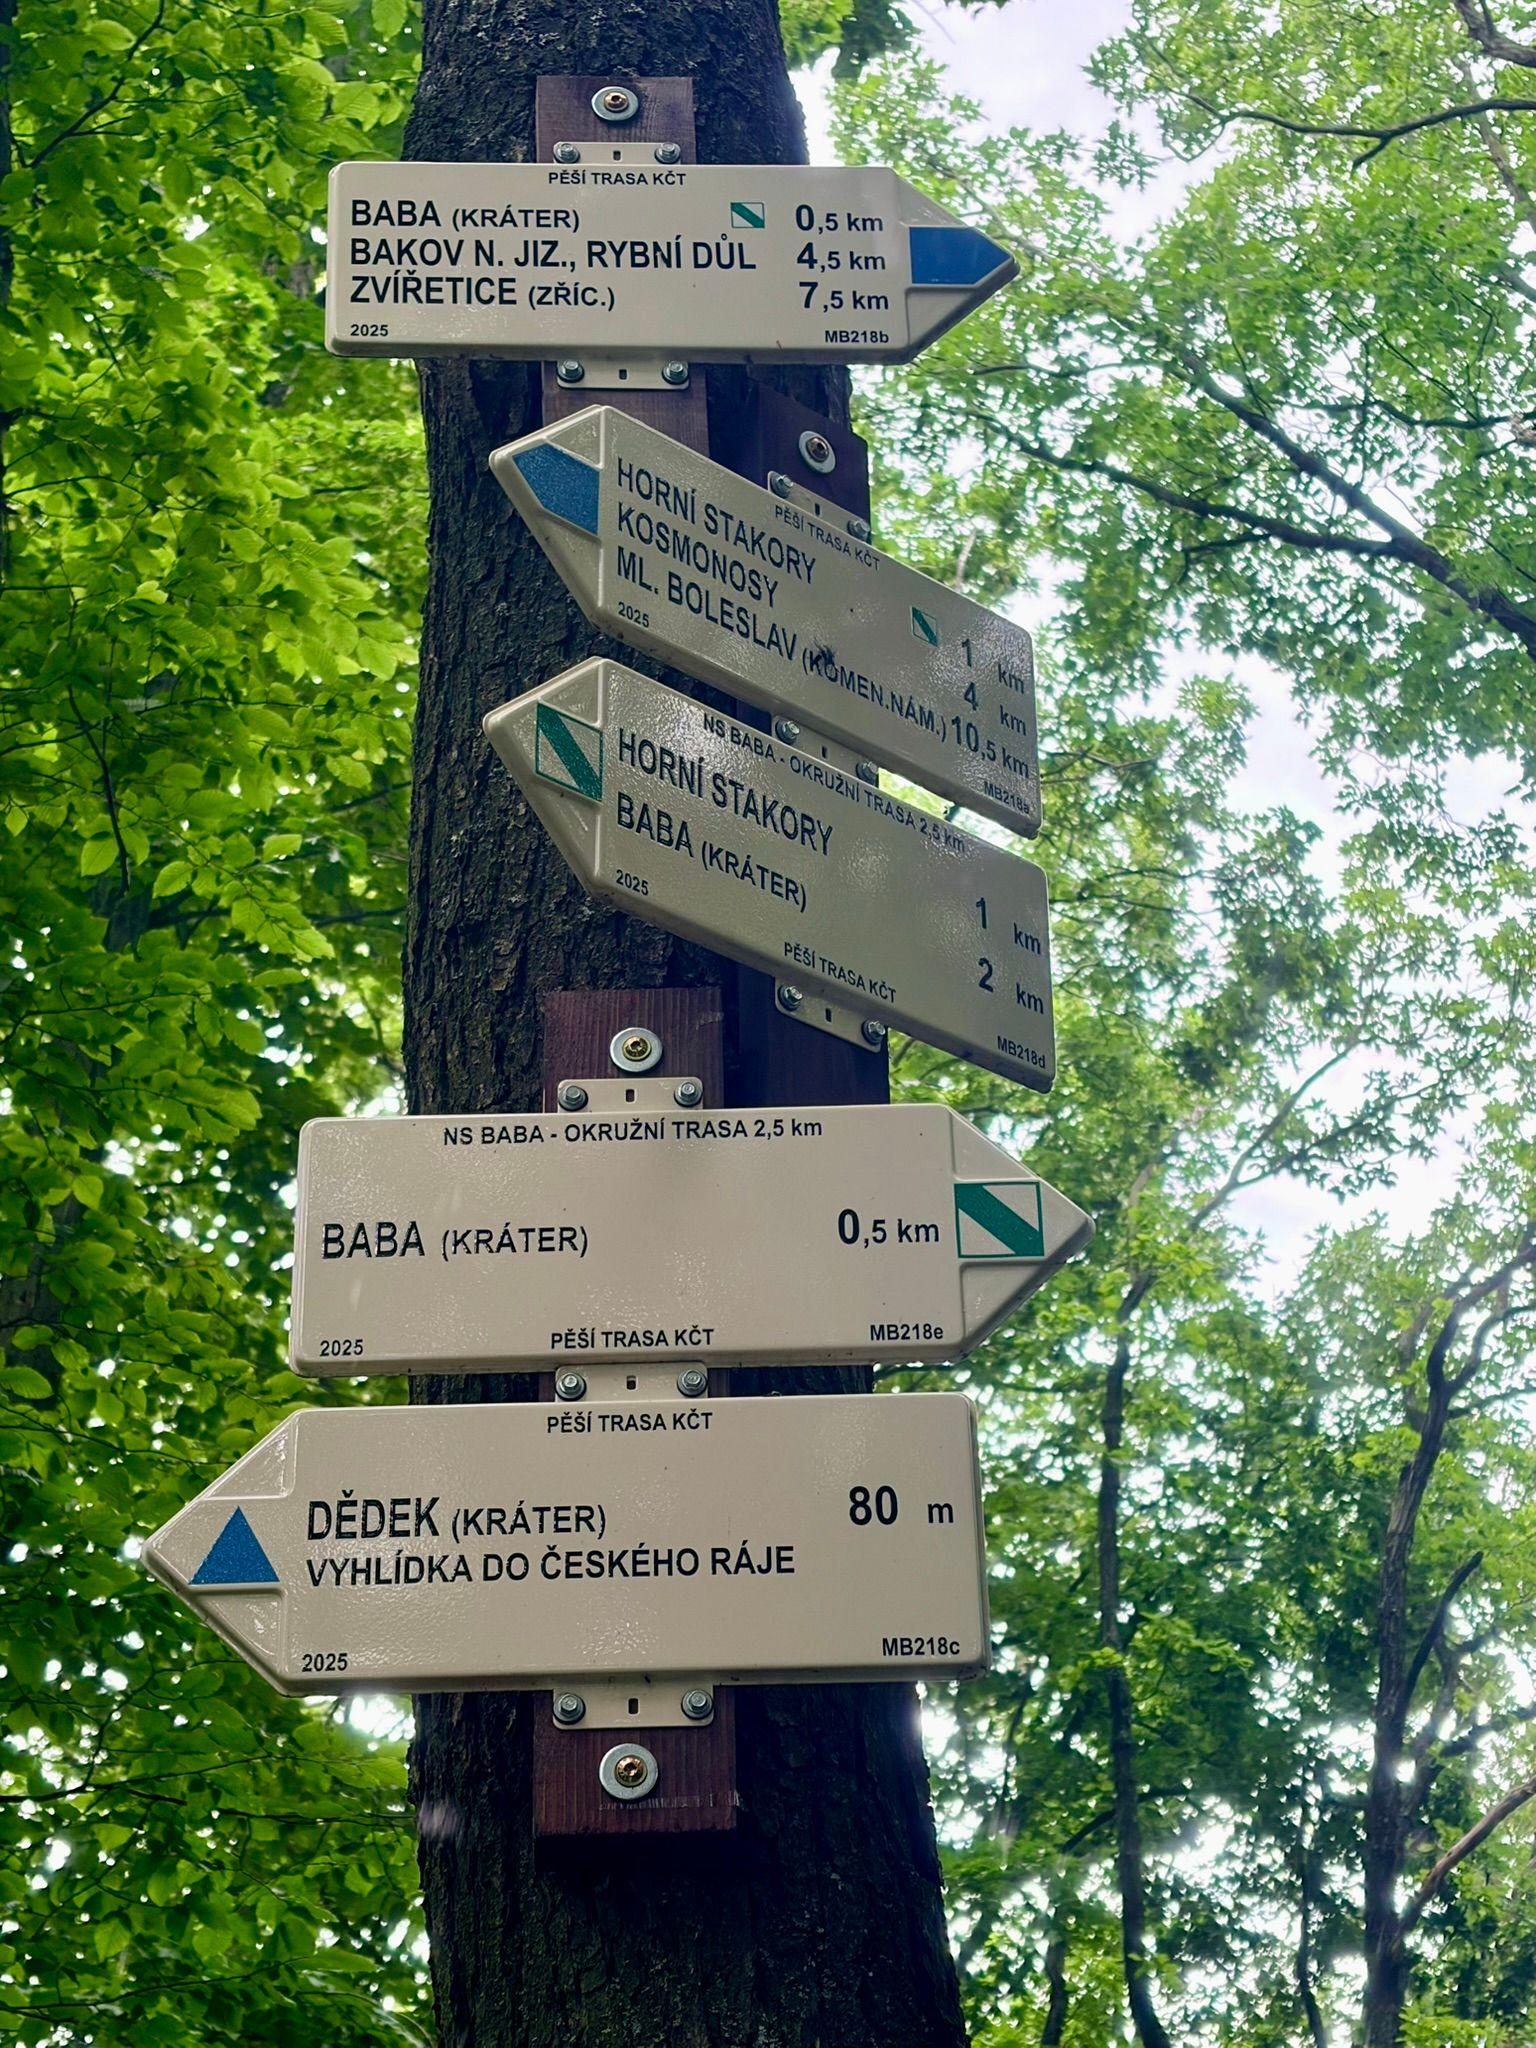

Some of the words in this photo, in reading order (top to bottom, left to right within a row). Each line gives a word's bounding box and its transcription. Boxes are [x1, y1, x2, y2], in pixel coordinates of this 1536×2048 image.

[548, 169, 586, 185] PĚŠÍ
[591, 172, 648, 186] TRASA
[653, 170, 686, 186] KČT
[351, 200, 441, 227] BABA
[452, 204, 579, 233] (KRÁTER)
[795, 204, 838, 234] 0,5
[847, 213, 883, 231] km
[351, 238, 464, 266] BAKOV
[475, 240, 503, 267] N.
[514, 240, 576, 272] JIZ.,
[587, 235, 682, 269] RYBNÍ
[693, 233, 757, 270] DŮL
[796, 242, 841, 273] 4,5
[850, 251, 886, 270] km
[350, 269, 517, 305] ZVÍŘETICE
[528, 282, 615, 311] (ZŘÍC.)
[853, 291, 888, 310] km
[350, 324, 388, 337] 2025
[824, 329, 889, 344] MB218b
[617, 457, 697, 524] HORNÍ
[704, 503, 816, 584] STAKORY
[775, 505, 804, 532] PĚŠÍ
[807, 522, 851, 556] TRASA
[855, 547, 880, 571] KČT
[618, 502, 778, 608] KOSMONOSY
[617, 546, 659, 594] ML.
[668, 571, 797, 661] BOLESLAV
[618, 601, 650, 628] 2025
[961, 638, 973, 667] 1
[998, 663, 1025, 694] km
[963, 682, 979, 711] 4
[1000, 704, 1027, 736] km
[952, 715, 997, 762] 10,5
[1002, 747, 1030, 779] km
[618, 728, 704, 799] HORNÍ
[712, 772, 833, 856] STAKORY
[703, 713, 726, 738] NS
[730, 728, 776, 763] BABA
[789, 755, 860, 802] OKRUŽNÍ
[864, 790, 916, 830] TRASA
[920, 817, 940, 840] 2,5
[944, 827, 965, 852] km
[984, 781, 1030, 814] MB218a
[617, 791, 694, 858] BABA
[701, 840, 806, 914] (KRÁTER)
[616, 869, 649, 896] 2025
[975, 897, 987, 930] 1
[1013, 923, 1041, 955] km
[784, 941, 815, 968] PĚŠÍ
[819, 957, 866, 992] TRASA
[869, 979, 897, 1003] KČT
[978, 957, 994, 993] 2
[1016, 983, 1044, 1014] km
[997, 1035, 1046, 1069] MB218d
[443, 1126, 473, 1146] NS
[481, 1125, 544, 1145] BABA
[565, 1118, 665, 1142] OKRUŽNÍ
[671, 1120, 748, 1140] TRASA
[754, 1119, 784, 1140] 2,5
[791, 1118, 823, 1137] km
[322, 1220, 425, 1260] BABA
[441, 1222, 588, 1262] (KRÁTER)
[837, 1208, 887, 1249] 0,5
[897, 1218, 939, 1243] km
[319, 1339, 364, 1357] 2025
[551, 1327, 595, 1350] PĚŠÍ
[601, 1330, 669, 1348] TRASA
[674, 1325, 714, 1347] KČT
[870, 1324, 944, 1341] MB218e
[547, 1411, 592, 1433] PĚŠÍ
[598, 1413, 667, 1432] TRASA
[672, 1409, 713, 1430] KČT
[307, 1489, 440, 1541] DĚDEK
[451, 1500, 606, 1544] (KRÁTER)
[848, 1485, 899, 1527] 80
[927, 1502, 955, 1524] m
[305, 1550, 473, 1587] VYHLÍDKA
[482, 1552, 530, 1582] DO
[540, 1543, 699, 1580] ČESKÉHO
[710, 1540, 795, 1576] RÁJE
[301, 1653, 348, 1672] 2025
[882, 1637, 960, 1657] MB218c
